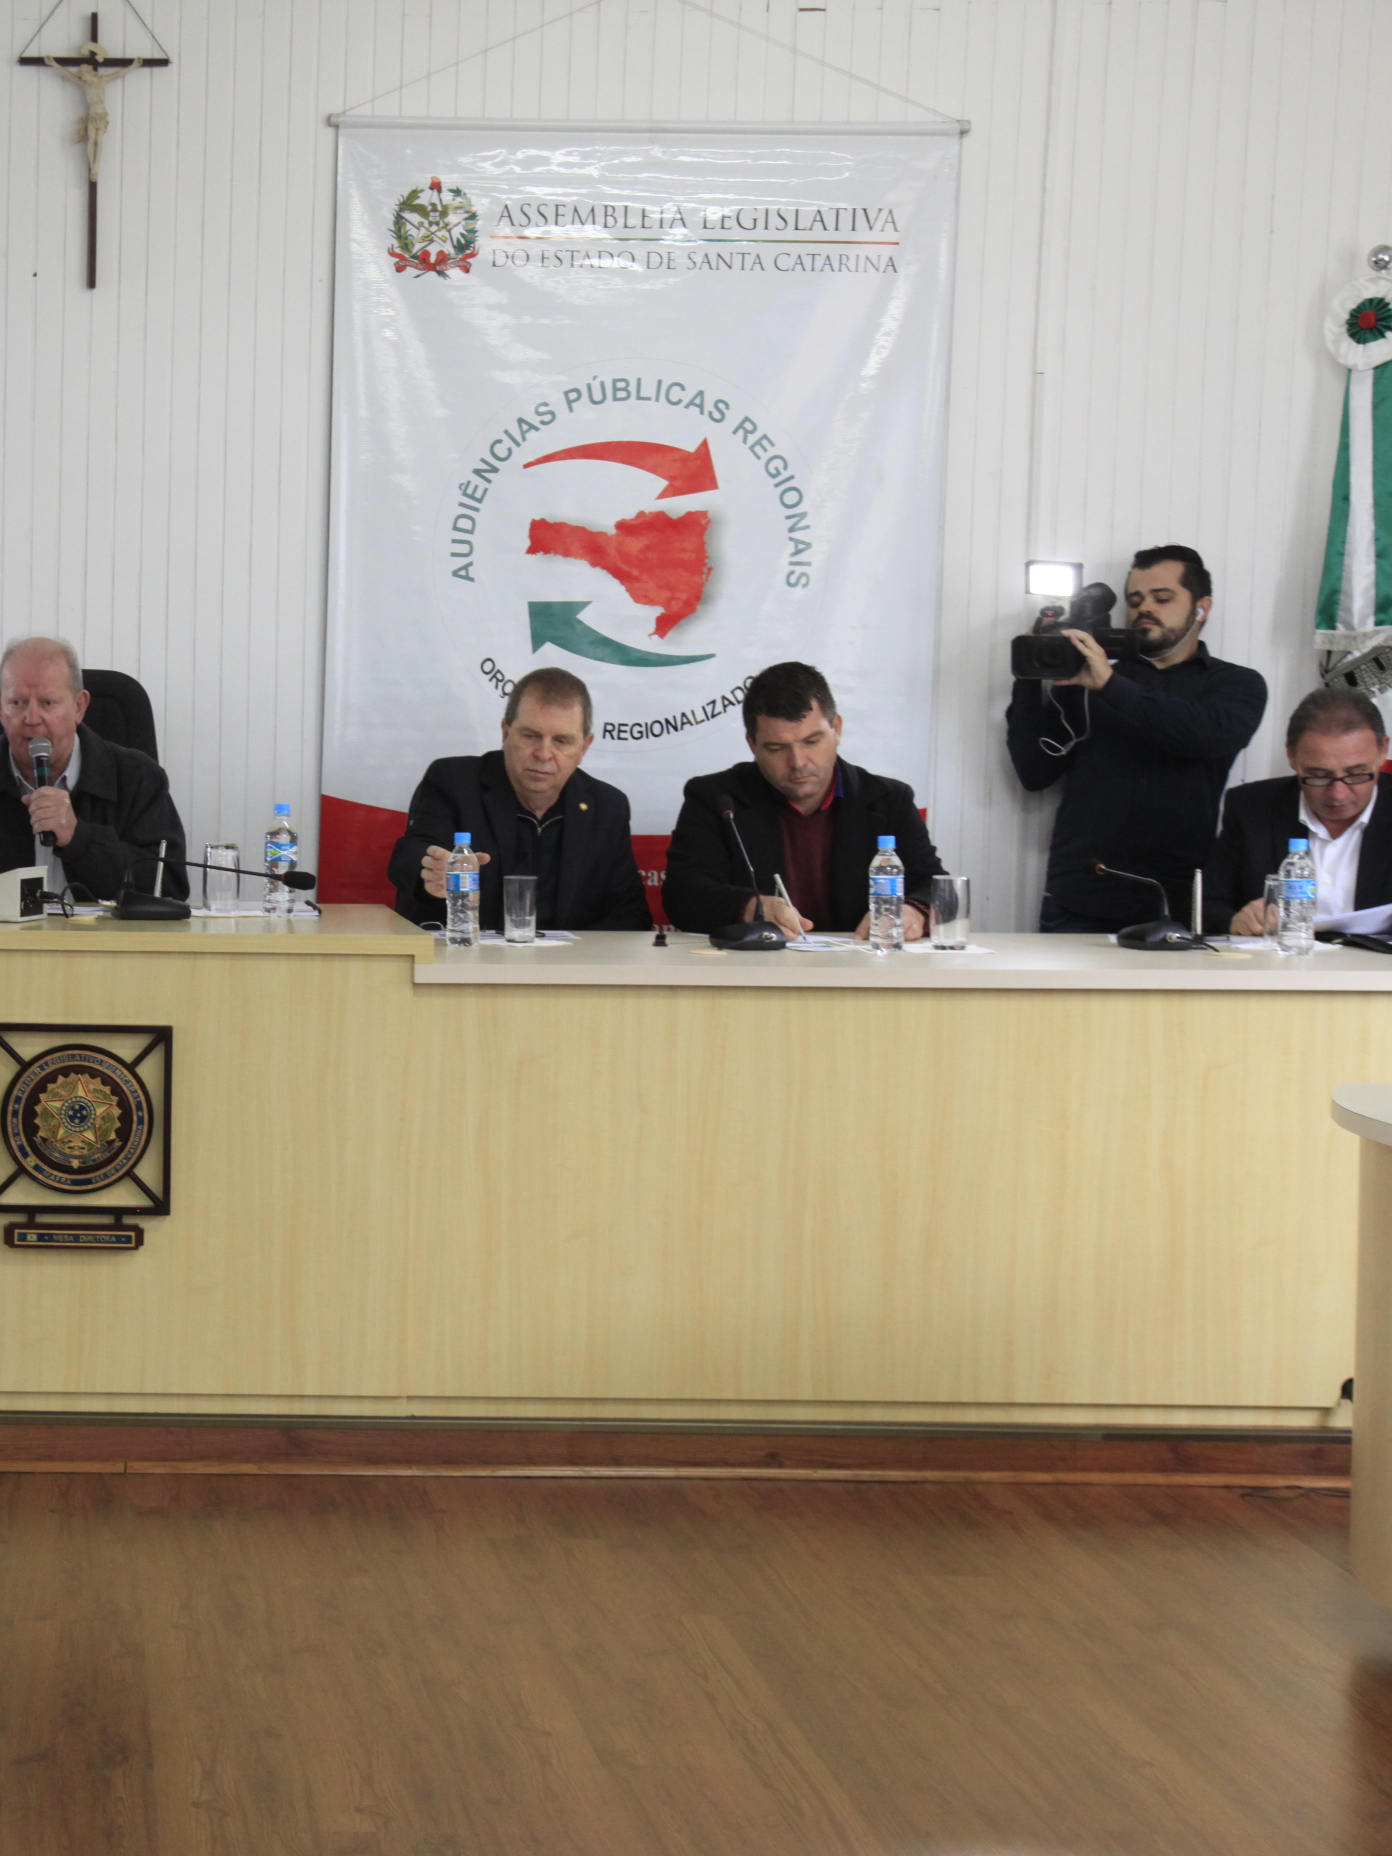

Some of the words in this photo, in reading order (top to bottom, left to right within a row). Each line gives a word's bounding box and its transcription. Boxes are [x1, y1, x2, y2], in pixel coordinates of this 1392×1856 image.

[496, 203, 689, 229] ASSEMBLEIA
[702, 205, 900, 232] LEGISLATIVA
[491, 249, 530, 268] DO
[541, 249, 636, 269] ESTADO
[646, 251, 677, 270] DE
[686, 251, 766, 272] SANTA
[773, 252, 899, 273] CATARINA
[450, 401, 557, 582] AUDIÊNCIAS
[562, 375, 730, 423] PÚBLICAS
[731, 415, 813, 589] REGIONAIS
[17, 1067, 43, 1097] PODER
[42, 1053, 101, 1070] LEGISLATIVO
[101, 1060, 141, 1105] MUNICIPAL
